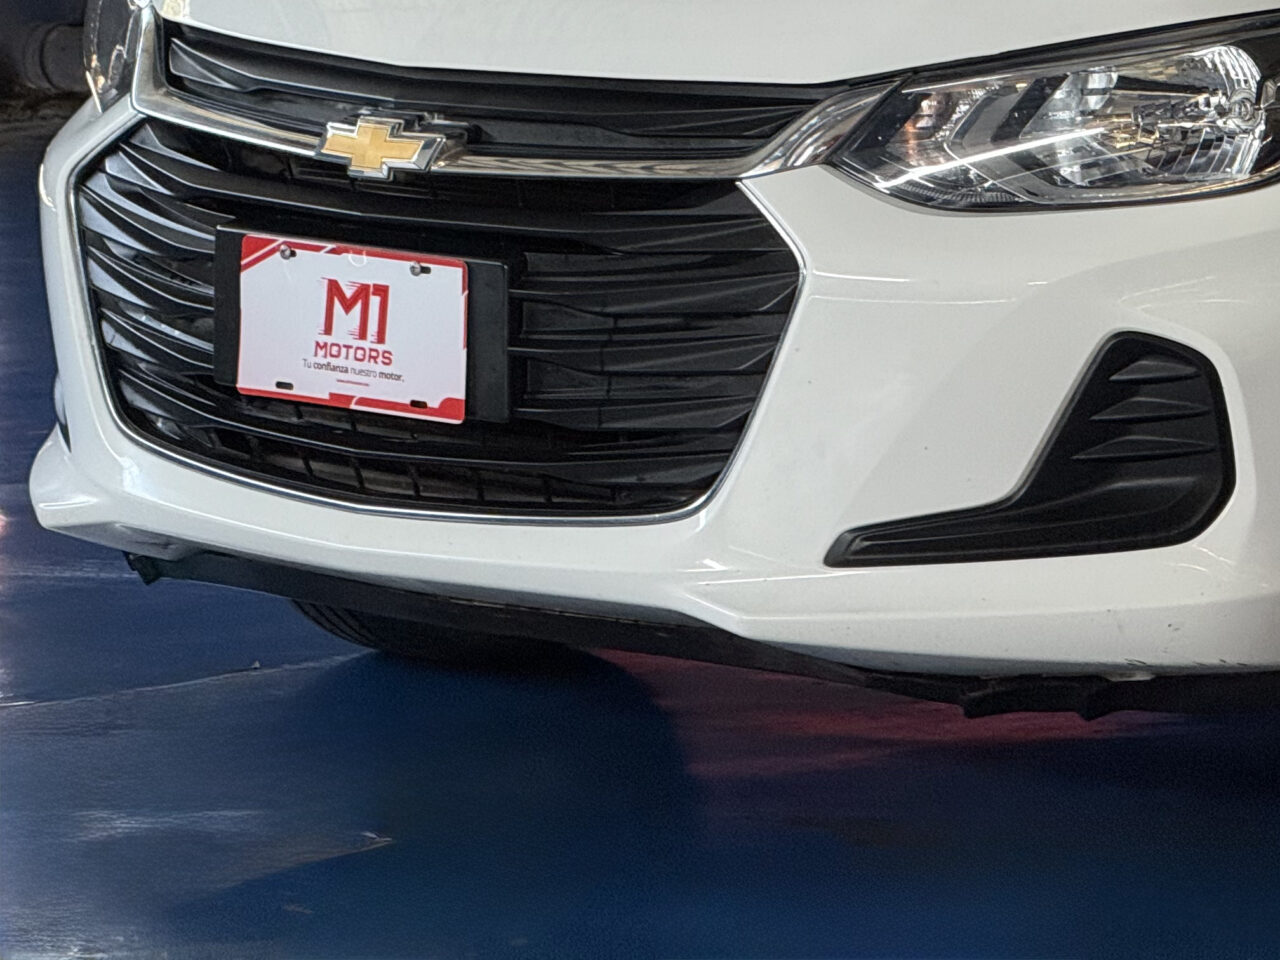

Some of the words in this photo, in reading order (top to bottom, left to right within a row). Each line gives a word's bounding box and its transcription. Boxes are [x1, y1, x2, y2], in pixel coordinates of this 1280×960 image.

[318, 278, 390, 344] M1
[313, 341, 393, 366] MOTORS
[302, 358, 313, 369] Tu
[313, 361, 349, 375] confianza
[350, 367, 378, 378] nuestro
